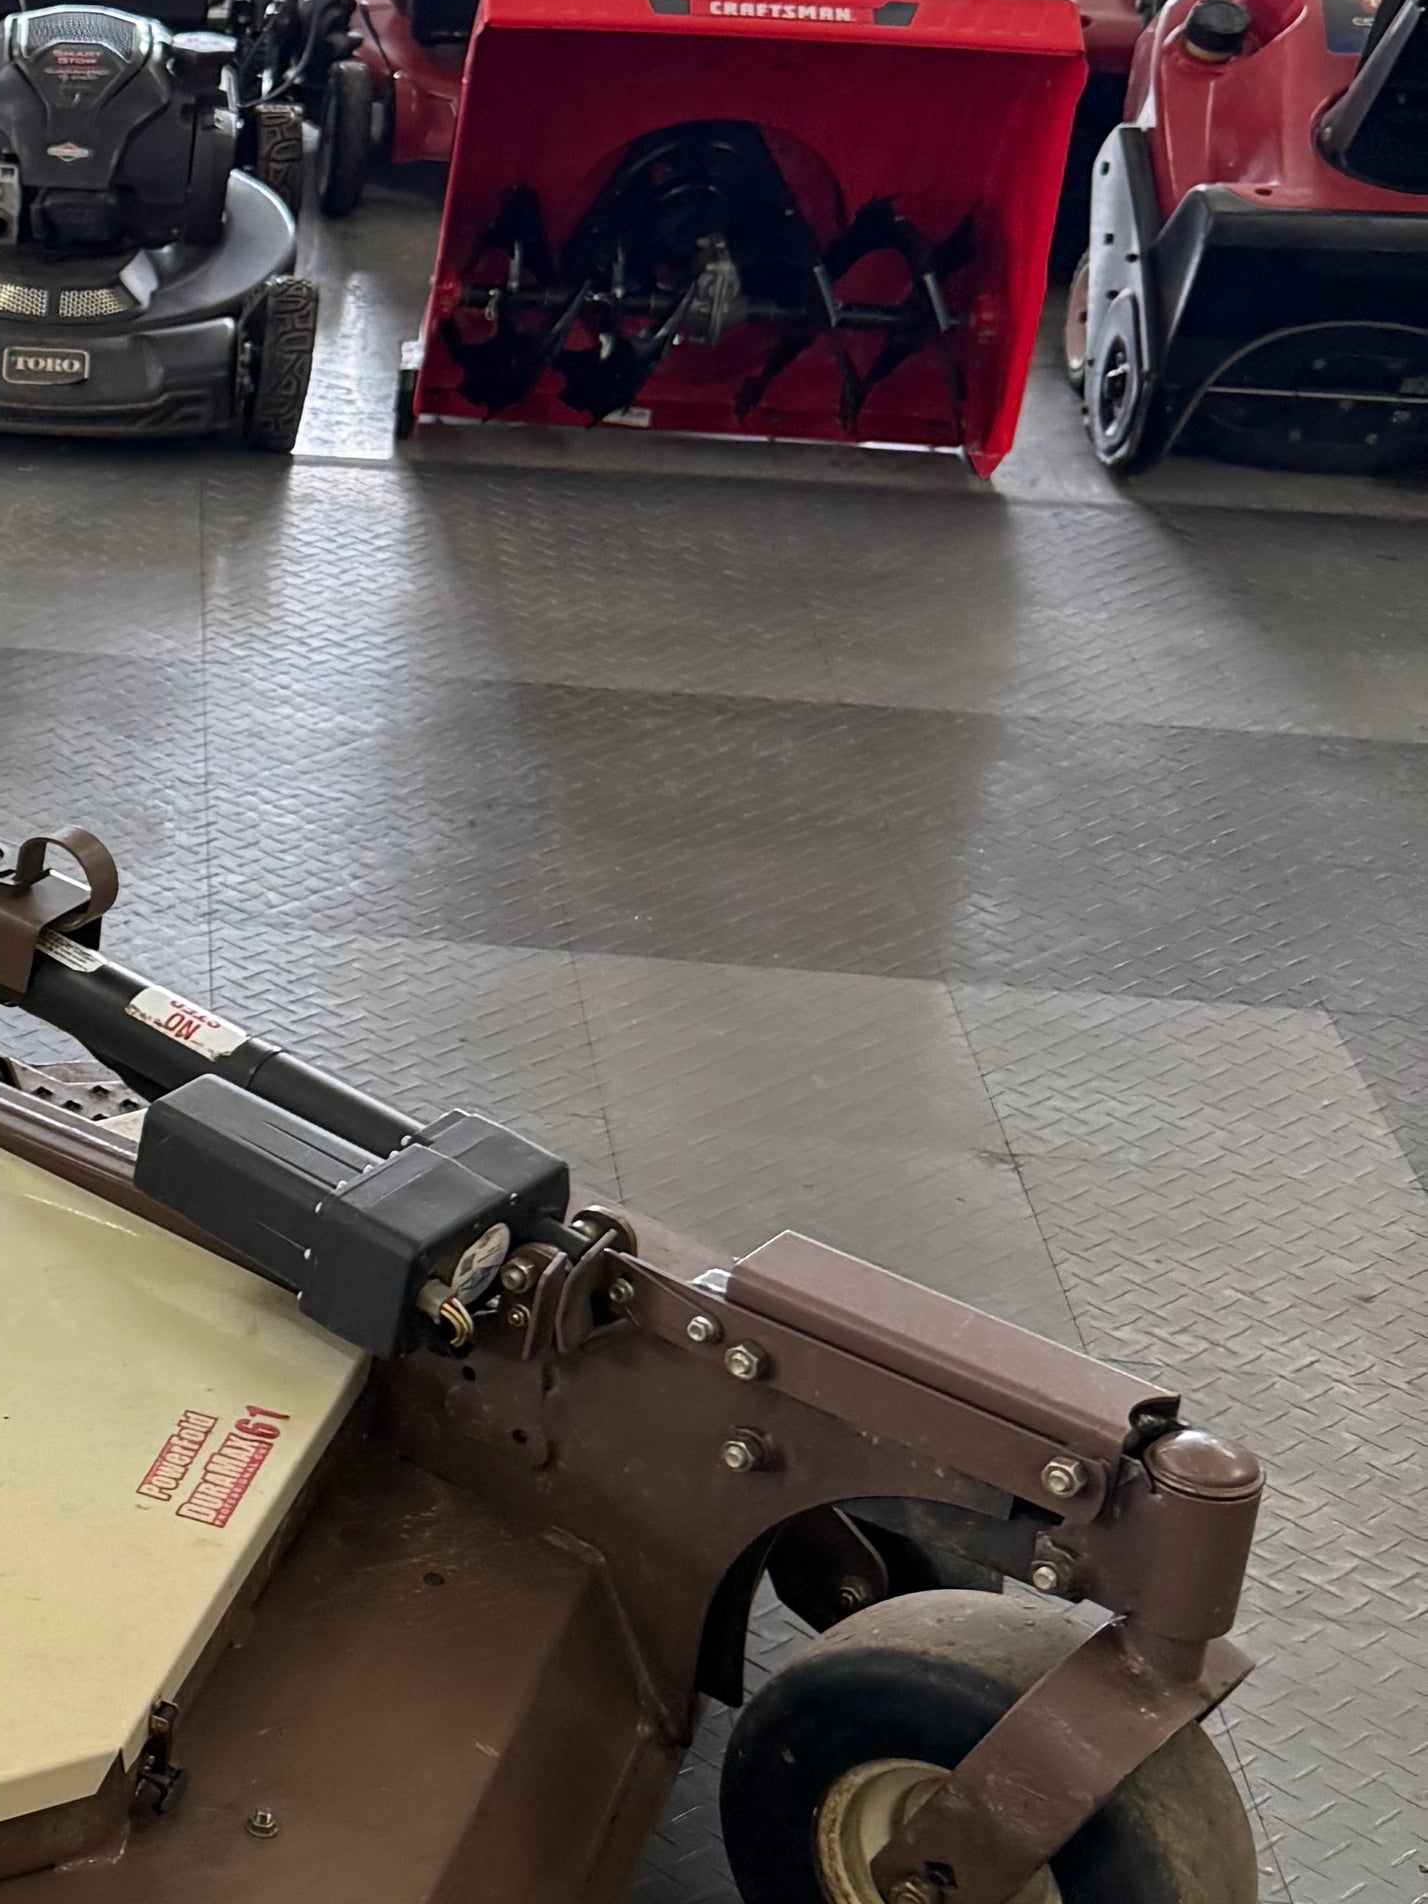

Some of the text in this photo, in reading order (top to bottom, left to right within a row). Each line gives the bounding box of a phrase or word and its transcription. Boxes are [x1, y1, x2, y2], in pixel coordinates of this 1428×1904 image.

[709, 0, 852, 22] CRAFTSMAN
[10, 355, 82, 373] TORO
[164, 1012, 202, 1041] NO
[234, 1404, 291, 1440] 61
